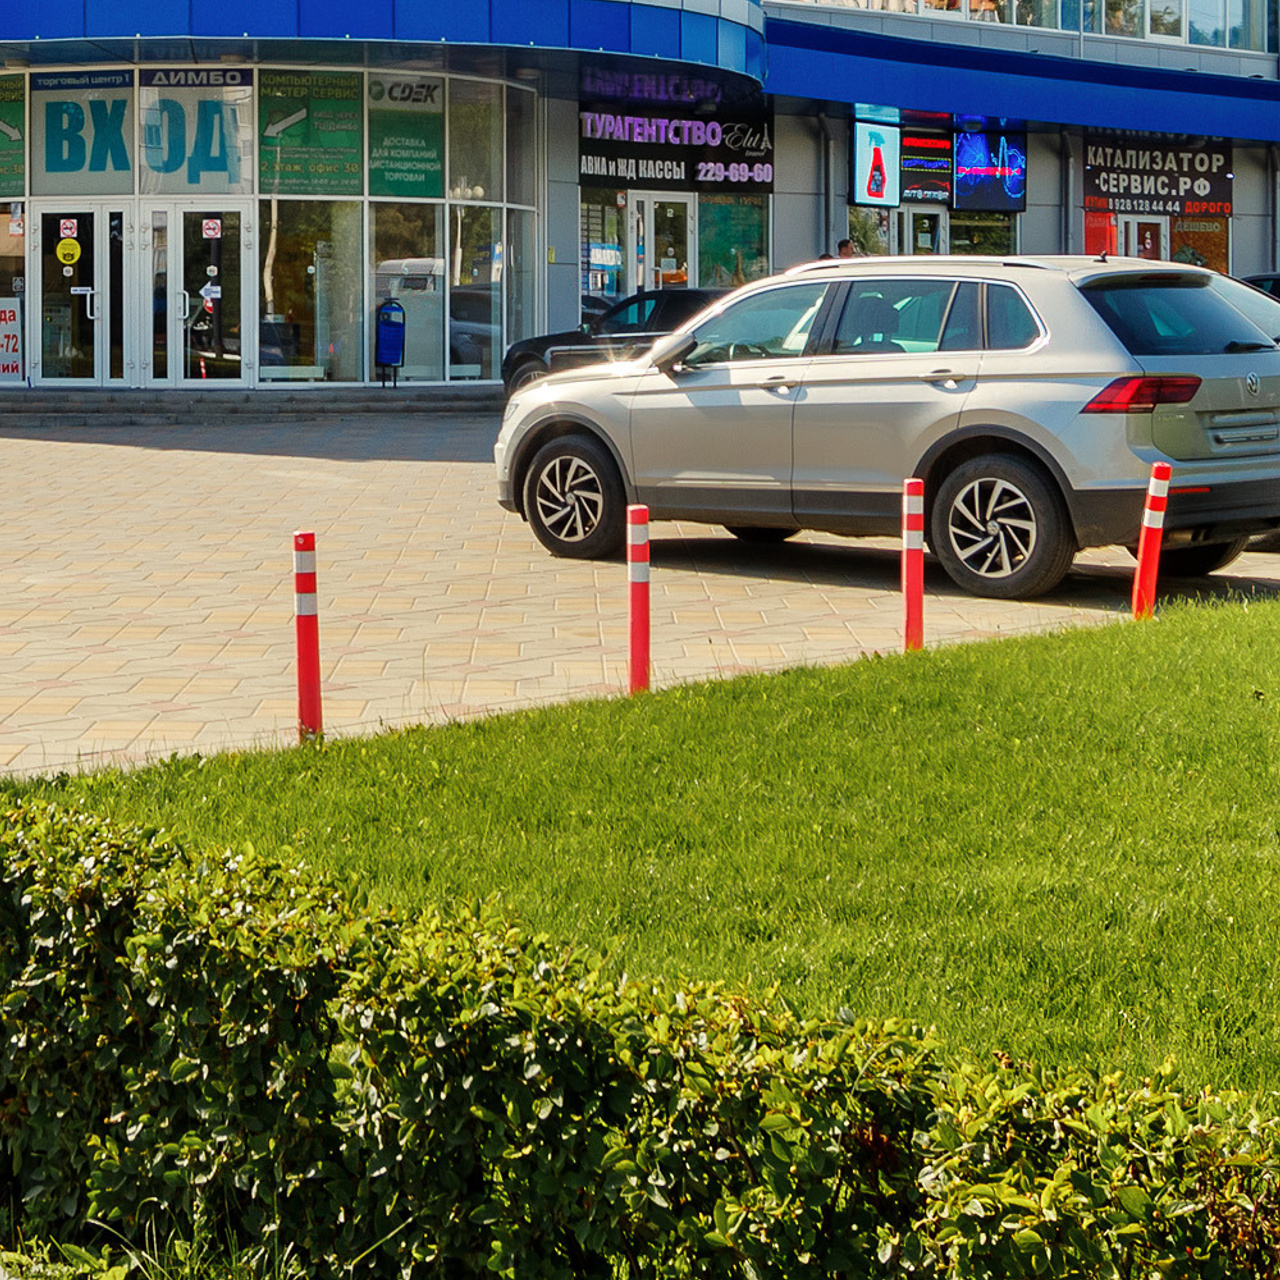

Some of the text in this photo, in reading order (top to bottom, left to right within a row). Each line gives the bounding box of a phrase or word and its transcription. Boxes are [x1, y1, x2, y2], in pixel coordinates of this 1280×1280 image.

[152, 71, 241, 85] ДИМБО
[260, 73, 359, 87] КОМПЬЮТЕРНЫЙ
[260, 87, 359, 99] МАСТЕР СЕРВИС
[388, 82, 440, 104] CDEK
[581, 112, 722, 147] ТУРАГЕНТСТВО
[45, 99, 241, 184] ВХОД
[382, 137, 426, 148] ДОСТАВКА
[371, 148, 437, 159] ДЛЯ КОМПАНИЙ
[1087, 145, 1225, 173] КАТАЛИЗАТОР
[581, 155, 608, 176] АВИА
[617, 158, 637, 180] ЖД
[638, 159, 685, 180] КАССЫ
[697, 162, 773, 183] 229-69-60
[384, 172, 425, 182] ТОРГОВЛИ
[1114, 198, 1132, 211] 928
[1152, 200, 1163, 212] 44
[1165, 201, 1180, 213] 44
[1184, 201, 1231, 214] ДОРОГО
[1174, 221, 1221, 233] ДЕШЕВО
